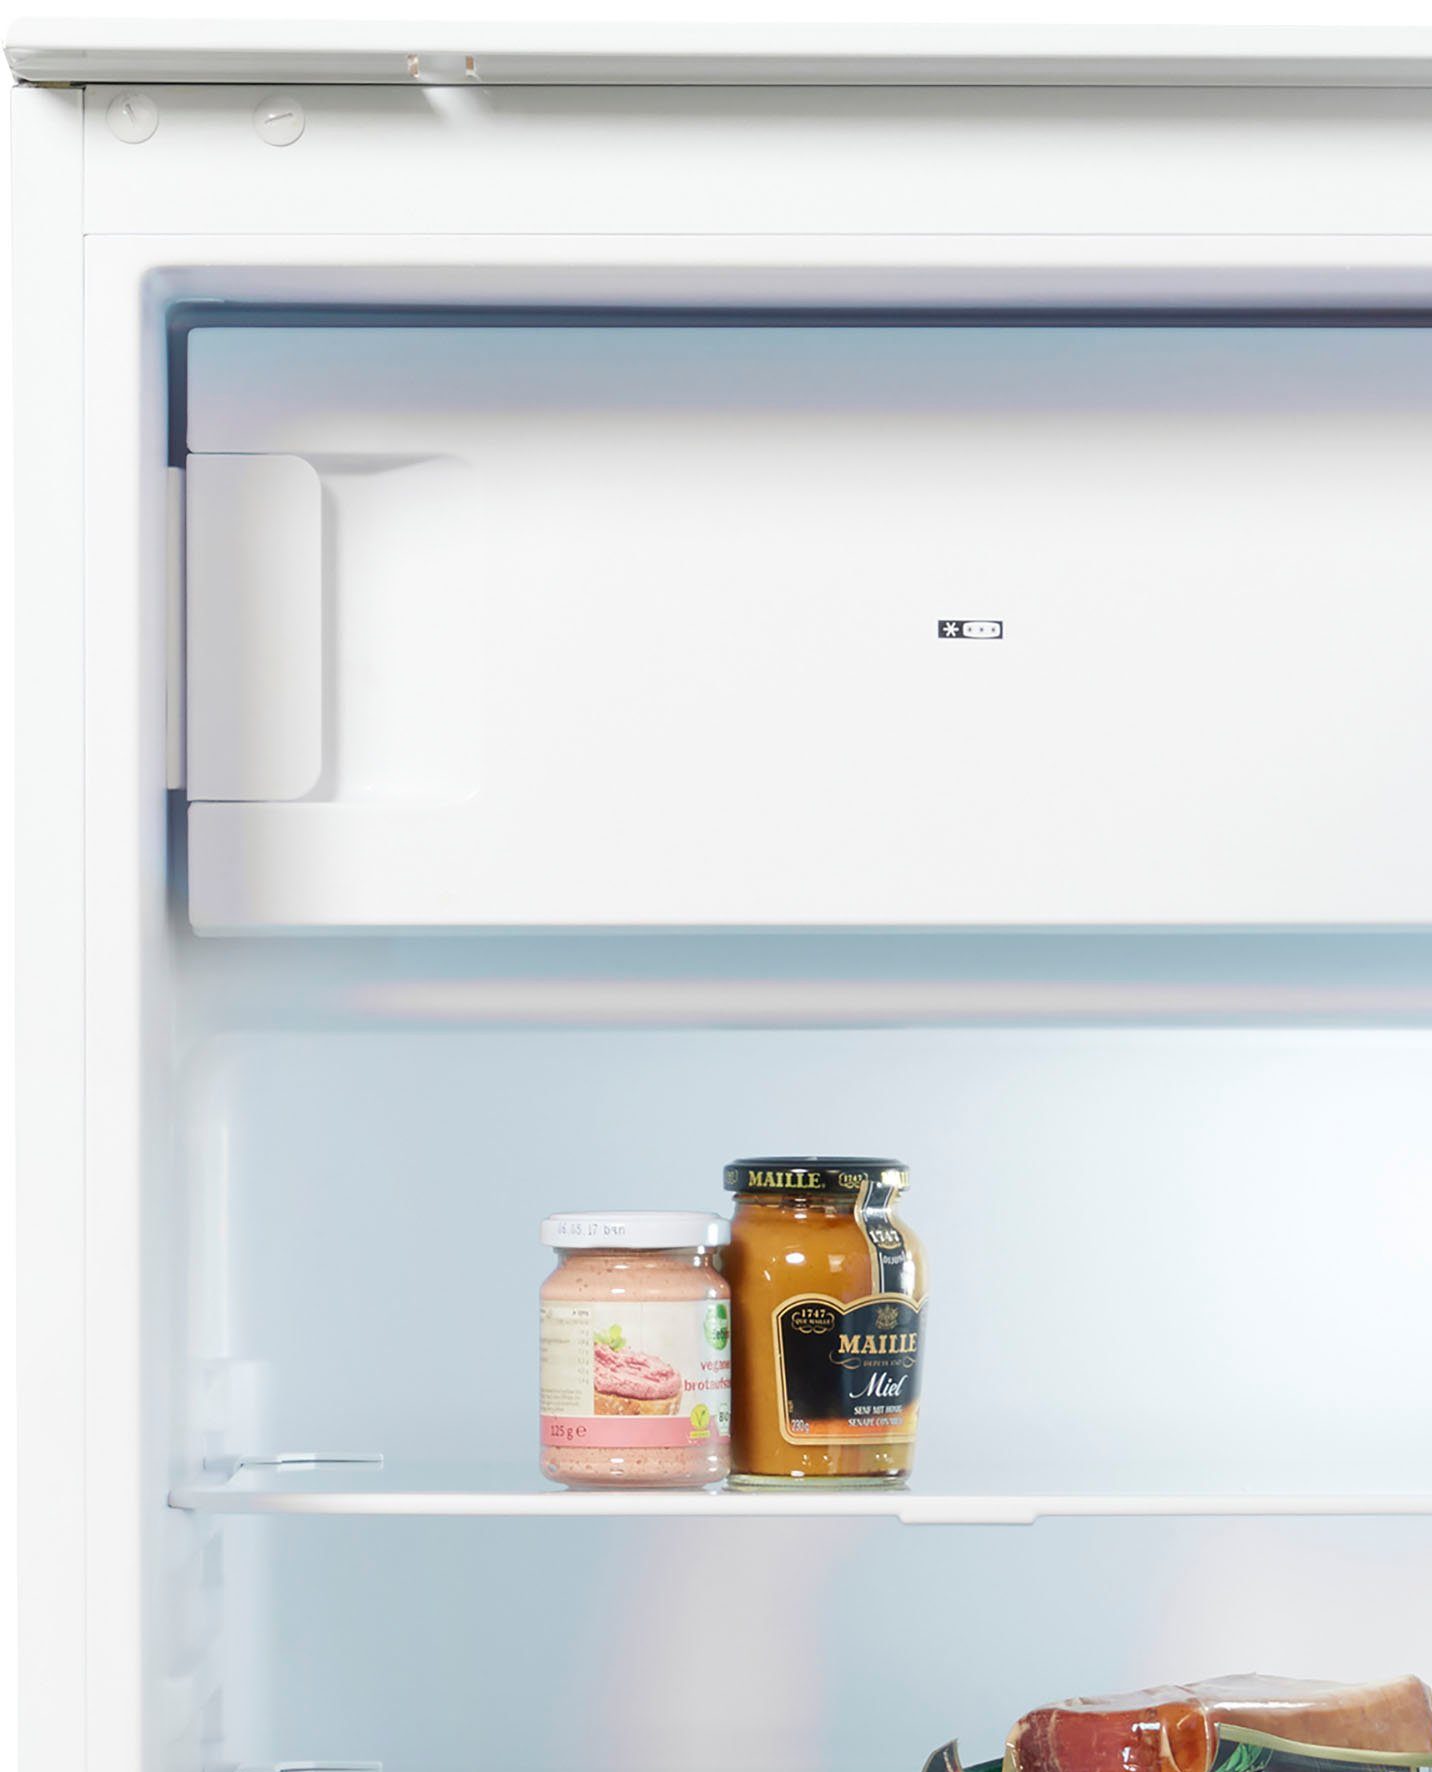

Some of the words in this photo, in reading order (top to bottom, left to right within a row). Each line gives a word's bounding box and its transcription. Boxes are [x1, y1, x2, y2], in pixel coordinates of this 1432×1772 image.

[748, 1170, 821, 1189] MAILLE
[869, 1230, 900, 1244] 1747
[801, 1308, 826, 1319] 1747
[838, 1332, 917, 1355] MAILLE
[849, 1371, 908, 1399] Miel
